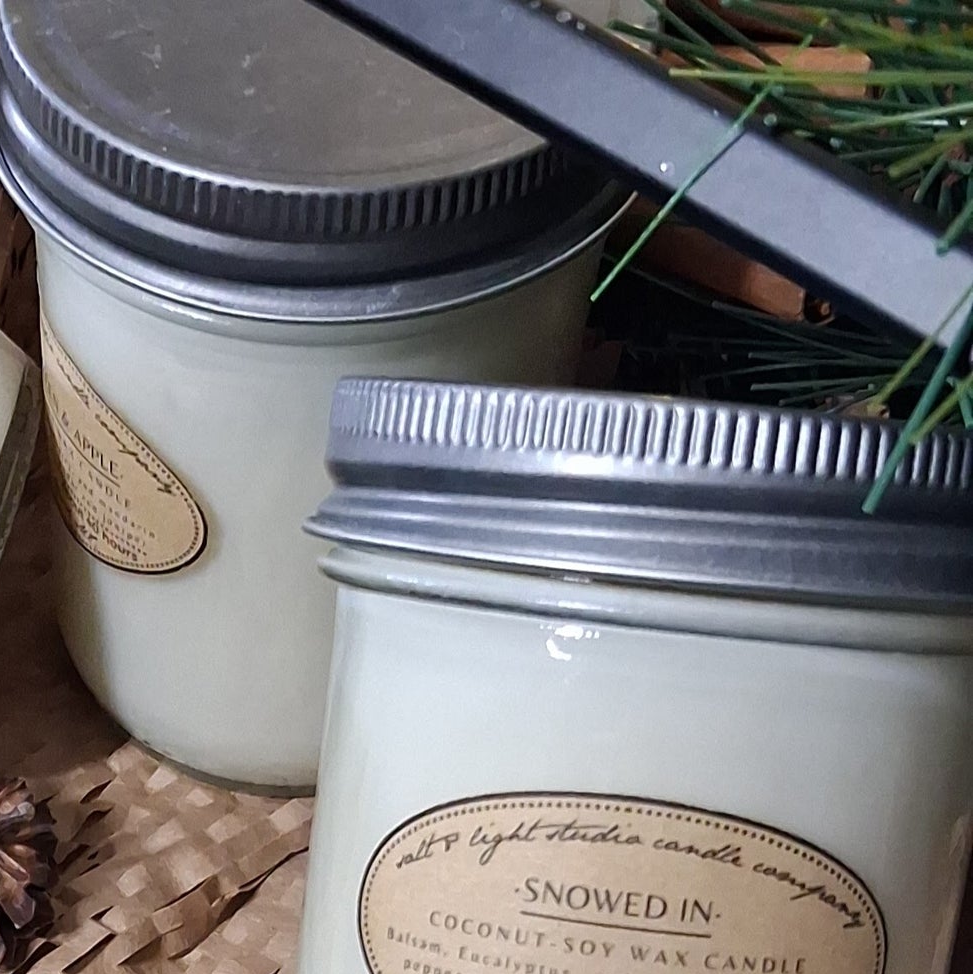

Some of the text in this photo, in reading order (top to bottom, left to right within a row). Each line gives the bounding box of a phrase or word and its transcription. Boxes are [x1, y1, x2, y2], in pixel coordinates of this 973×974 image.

[102, 530, 138, 561] hours
[469, 819, 541, 866] light
[543, 820, 643, 845] studio
[653, 839, 743, 868] candle
[752, 863, 865, 930] company
[630, 945, 689, 968] WAX
